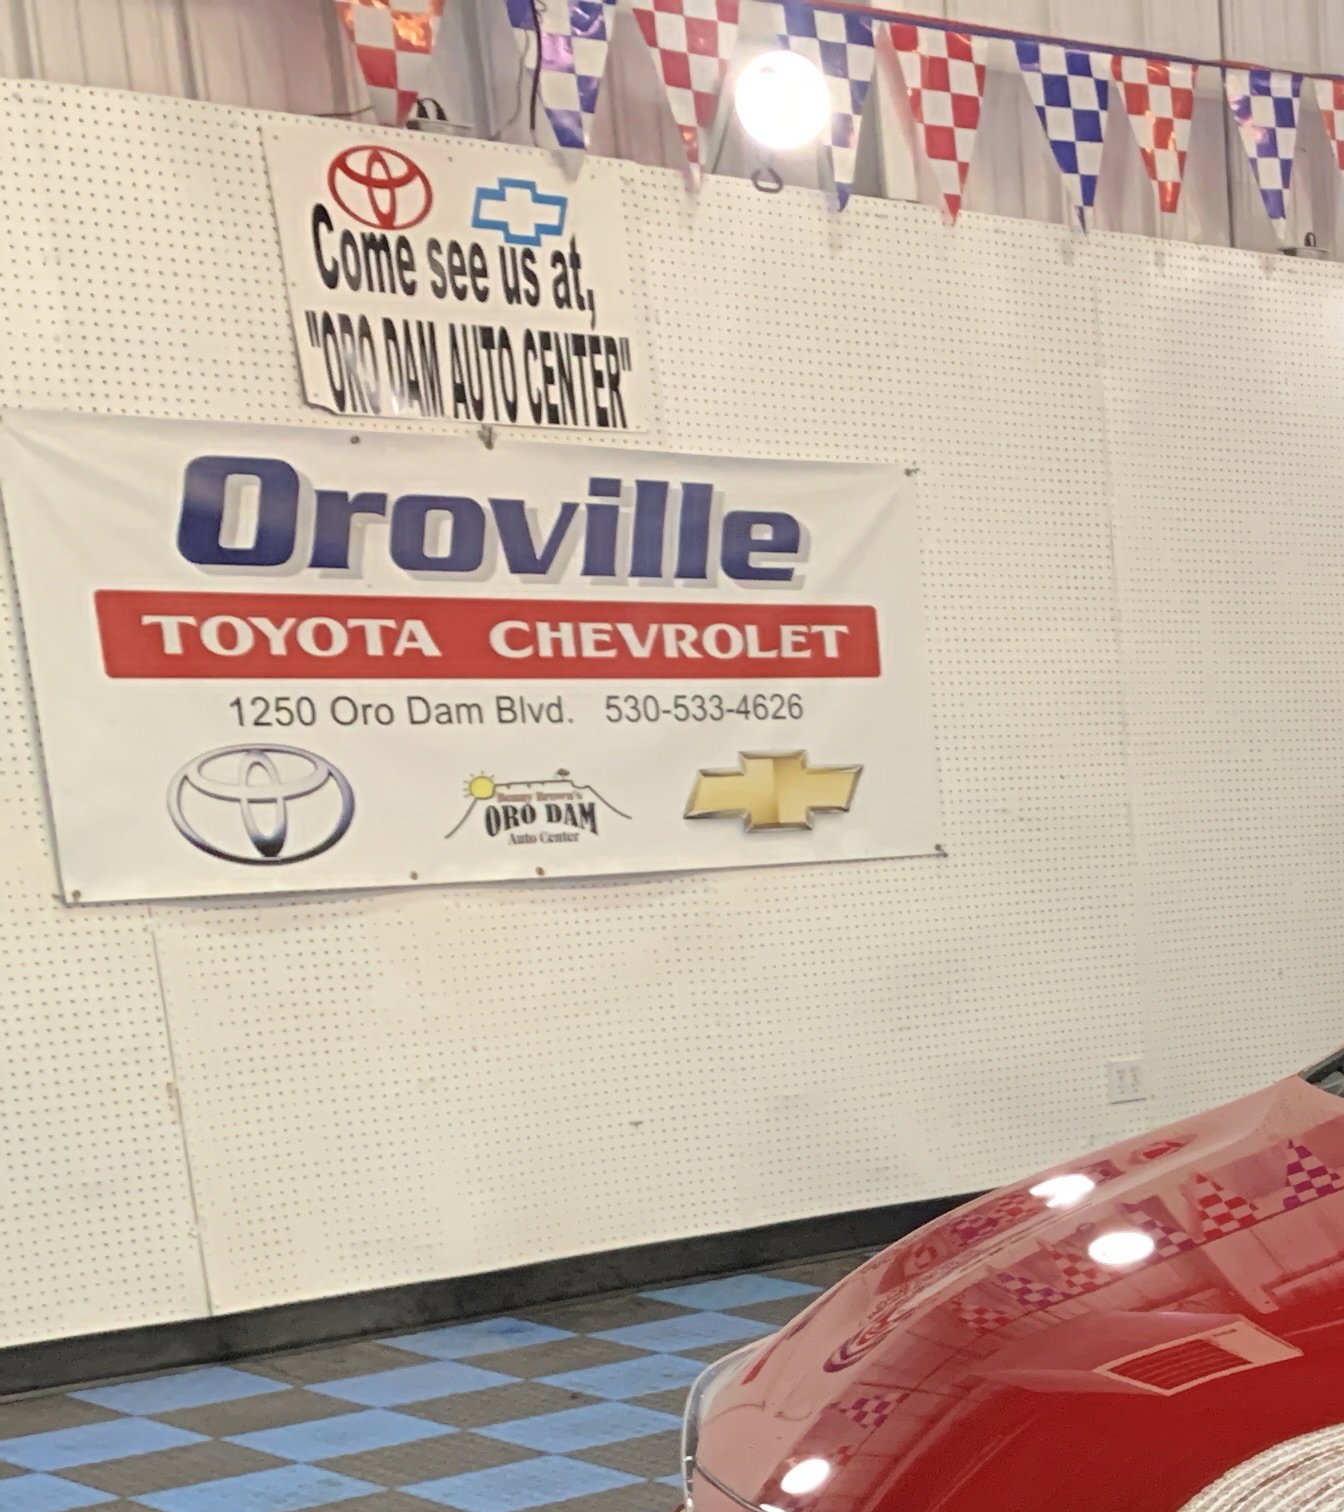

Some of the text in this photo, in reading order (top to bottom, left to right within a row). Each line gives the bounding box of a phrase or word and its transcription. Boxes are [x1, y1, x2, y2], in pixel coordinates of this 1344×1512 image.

[312, 203, 596, 330] Come see us at,
[382, 317, 445, 417] DAM
[449, 323, 518, 424] AUTO
[177, 455, 803, 584] Oroville
[141, 614, 849, 661] TOYOTA CHEVROLET
[228, 693, 804, 728] 1250 Oro Dam Blvd. 530-533-4626
[486, 801, 599, 837] ORO DAM
[510, 831, 580, 845] Auto Center
